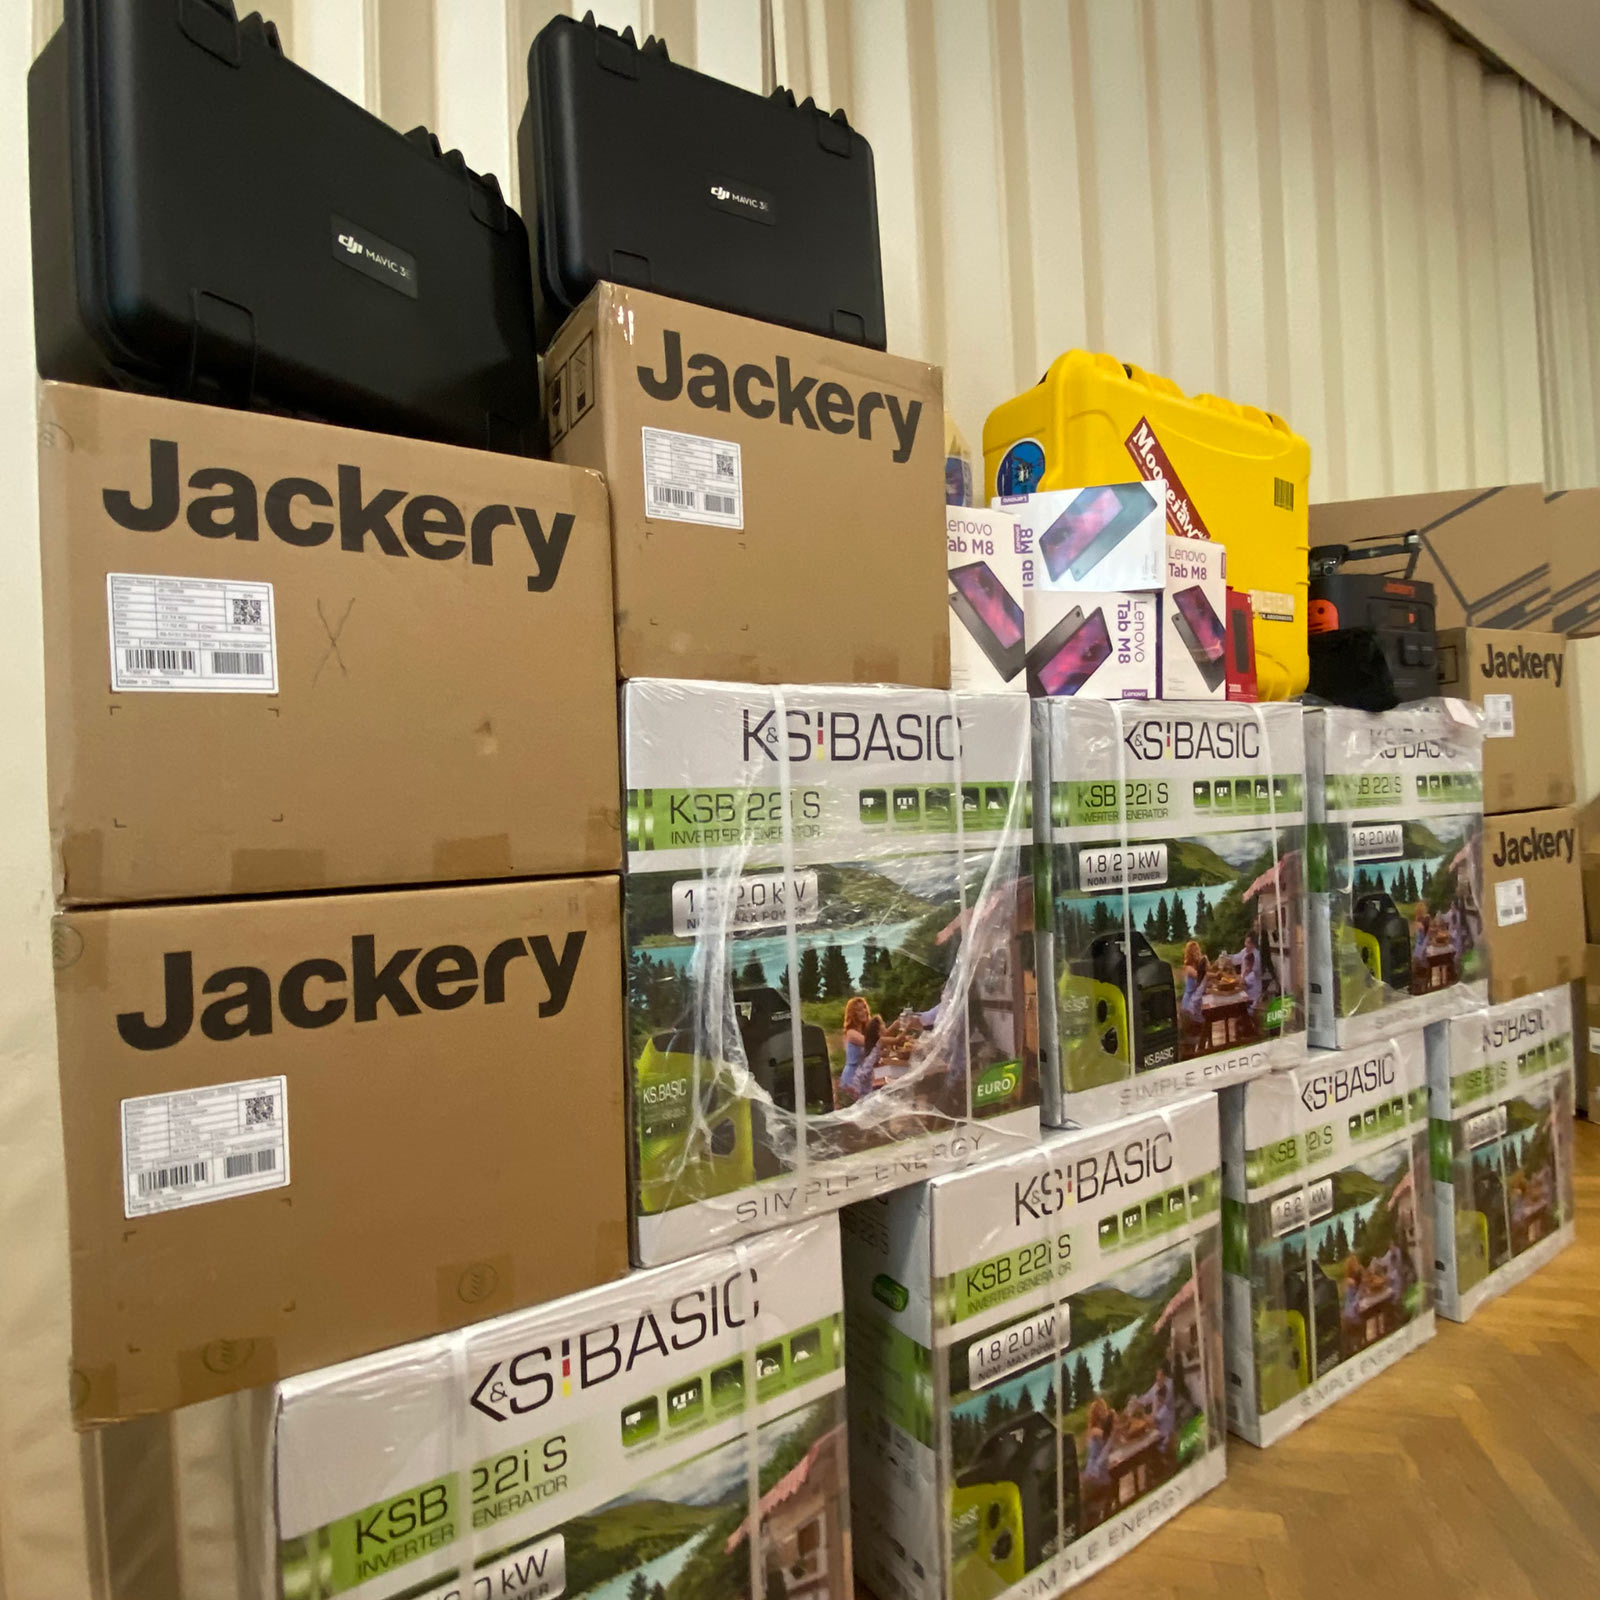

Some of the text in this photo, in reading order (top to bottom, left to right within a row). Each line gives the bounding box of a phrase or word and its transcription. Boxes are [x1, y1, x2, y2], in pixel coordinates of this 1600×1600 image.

[731, 193, 759, 208] MAVIC
[365, 248, 398, 273] MAVIC
[637, 330, 923, 463] Jackery
[1132, 422, 1202, 539] Mooejaw
[102, 438, 576, 593] Jackery
[947, 519, 992, 537] enovo
[947, 535, 994, 556] ab M8
[1168, 545, 1207, 564] Lenovo
[1168, 562, 1207, 581] Tab M8
[1117, 600, 1131, 664] Tab M8
[1134, 601, 1147, 663] Lenovo
[1481, 643, 1563, 688] Jackery
[830, 712, 963, 761] BASIC
[1174, 721, 1260, 760] BASIC
[670, 793, 736, 825] KSB
[803, 791, 821, 819] S
[1126, 808, 1169, 820] ENERATOR
[1157, 782, 1169, 804] S
[1138, 850, 1160, 869] kW
[1493, 826, 1575, 868] Jackery
[1132, 871, 1161, 882] POWER
[116, 930, 588, 1051] Jackery
[977, 1077, 1011, 1097] EURO
[1334, 1054, 1395, 1103] BASIC
[1324, 1125, 1333, 1145] S
[1077, 1132, 1174, 1203] BASIC
[966, 1233, 1071, 1297] KSB 22i S
[1017, 1261, 1072, 1294] GENERAOR
[579, 1267, 760, 1390] BASIC
[355, 1484, 448, 1554] KSB
[543, 1435, 568, 1473] S
[357, 1523, 455, 1580] INVERTER
[472, 1474, 569, 1526] ENERATOR
[501, 1548, 549, 1595] kW
